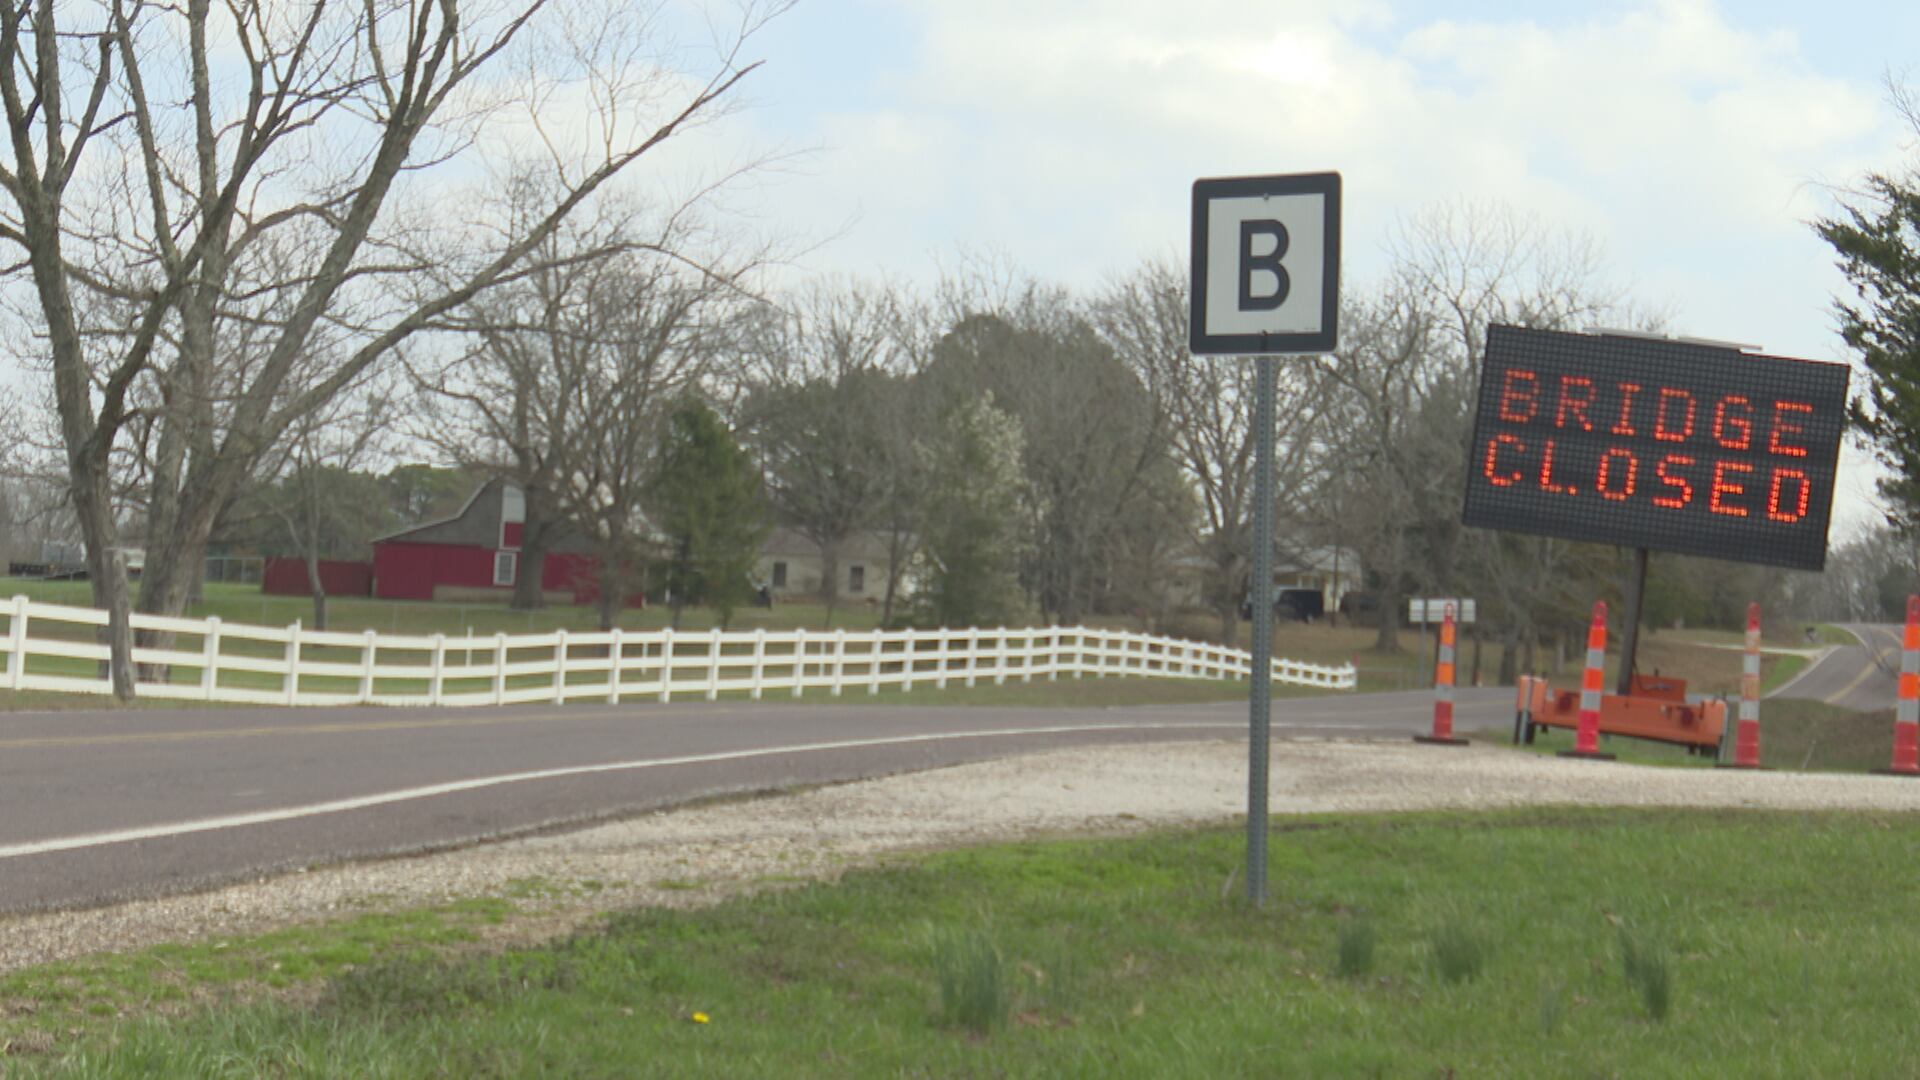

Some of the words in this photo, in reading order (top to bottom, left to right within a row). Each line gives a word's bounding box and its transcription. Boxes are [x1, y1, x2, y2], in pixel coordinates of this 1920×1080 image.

[1238, 219, 1290, 312] B
[1499, 368, 1813, 458] BRIDGE
[1483, 432, 1811, 524] CLOSED
